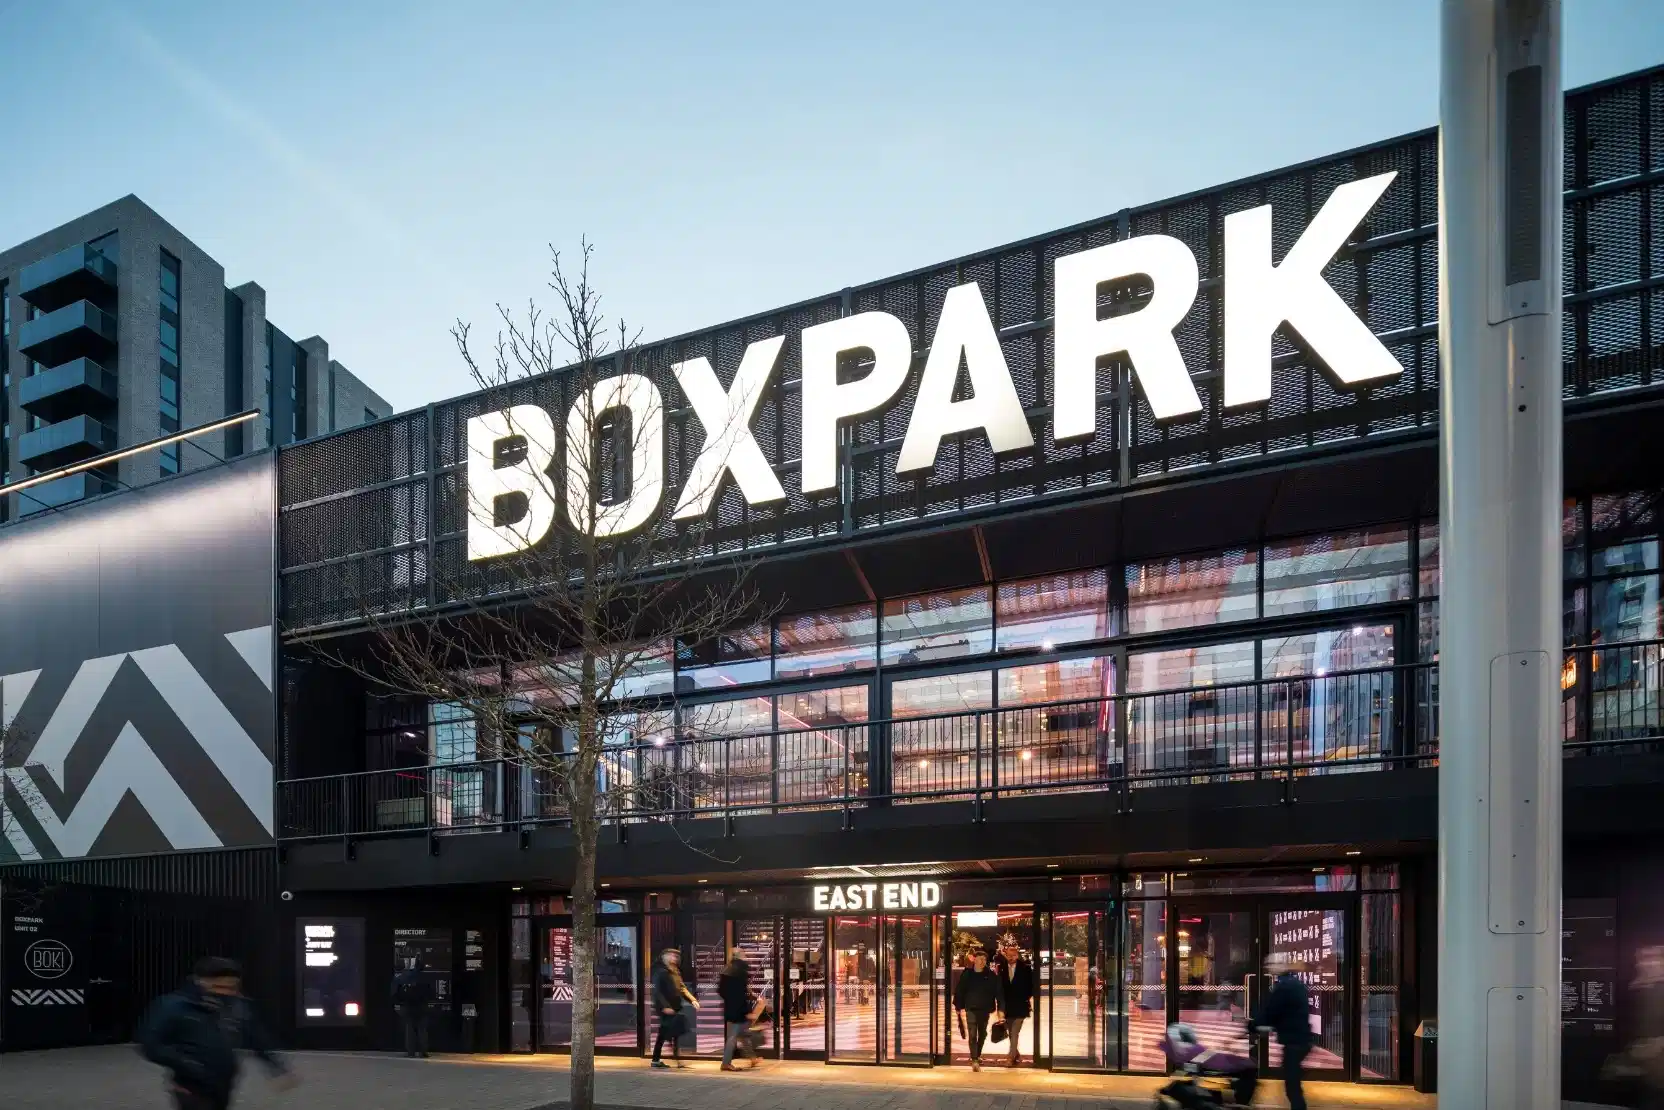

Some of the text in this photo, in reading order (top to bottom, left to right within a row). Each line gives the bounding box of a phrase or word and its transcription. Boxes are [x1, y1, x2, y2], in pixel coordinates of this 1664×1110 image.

[467, 170, 1404, 562] BOXPARK
[813, 882, 942, 911] EAST END
[14, 916, 44, 924] BOXPARK
[394, 928, 427, 936] DIRECTORY
[33, 950, 64, 968] BOKI
